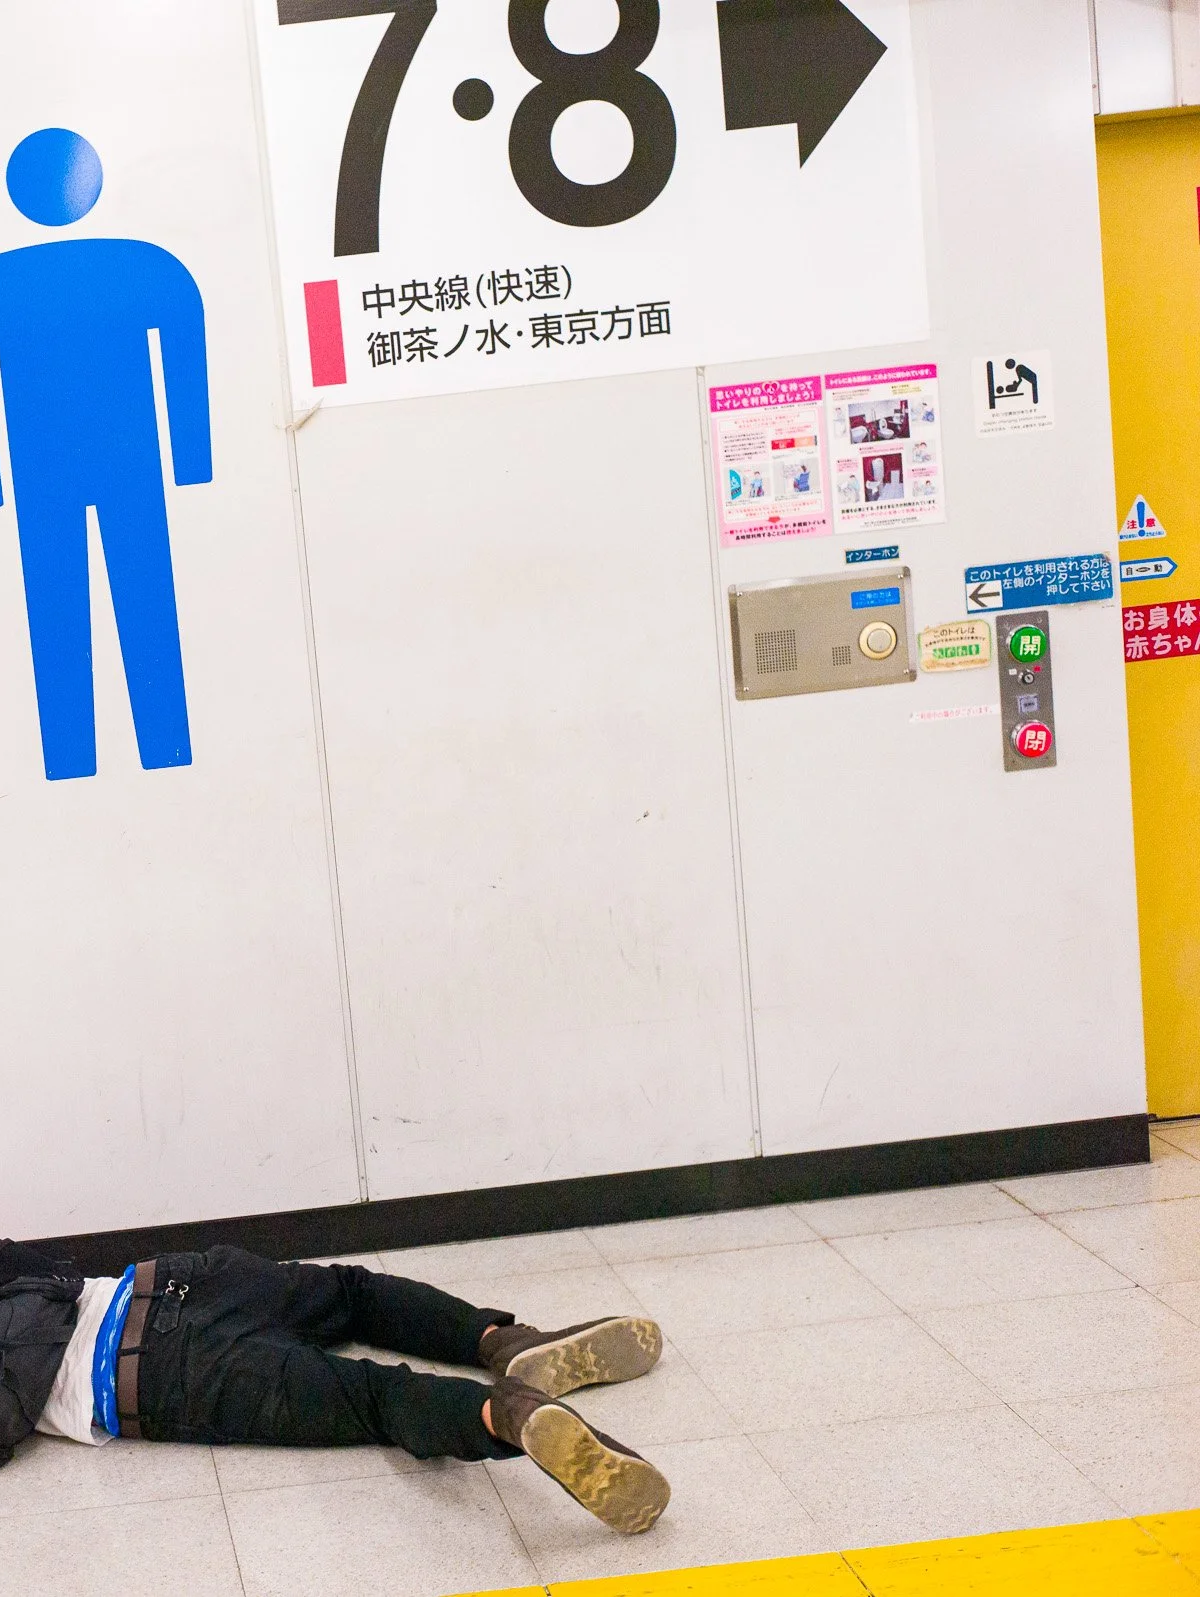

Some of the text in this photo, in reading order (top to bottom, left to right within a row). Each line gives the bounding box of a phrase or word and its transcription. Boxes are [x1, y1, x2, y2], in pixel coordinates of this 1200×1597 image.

[361, 264, 572, 319] 中央線(快速)
[366, 300, 672, 368] 御茶ノ水・東京方面
[846, 548, 899, 562] インターホン
[969, 557, 1110, 582] このトイレを利用される方は
[1002, 568, 1111, 590] 左側のインターホンを
[1046, 579, 1111, 596] 押して下さい
[1124, 602, 1200, 632] お身体
[1019, 635, 1042, 656] 開
[1023, 729, 1047, 751] 閉
